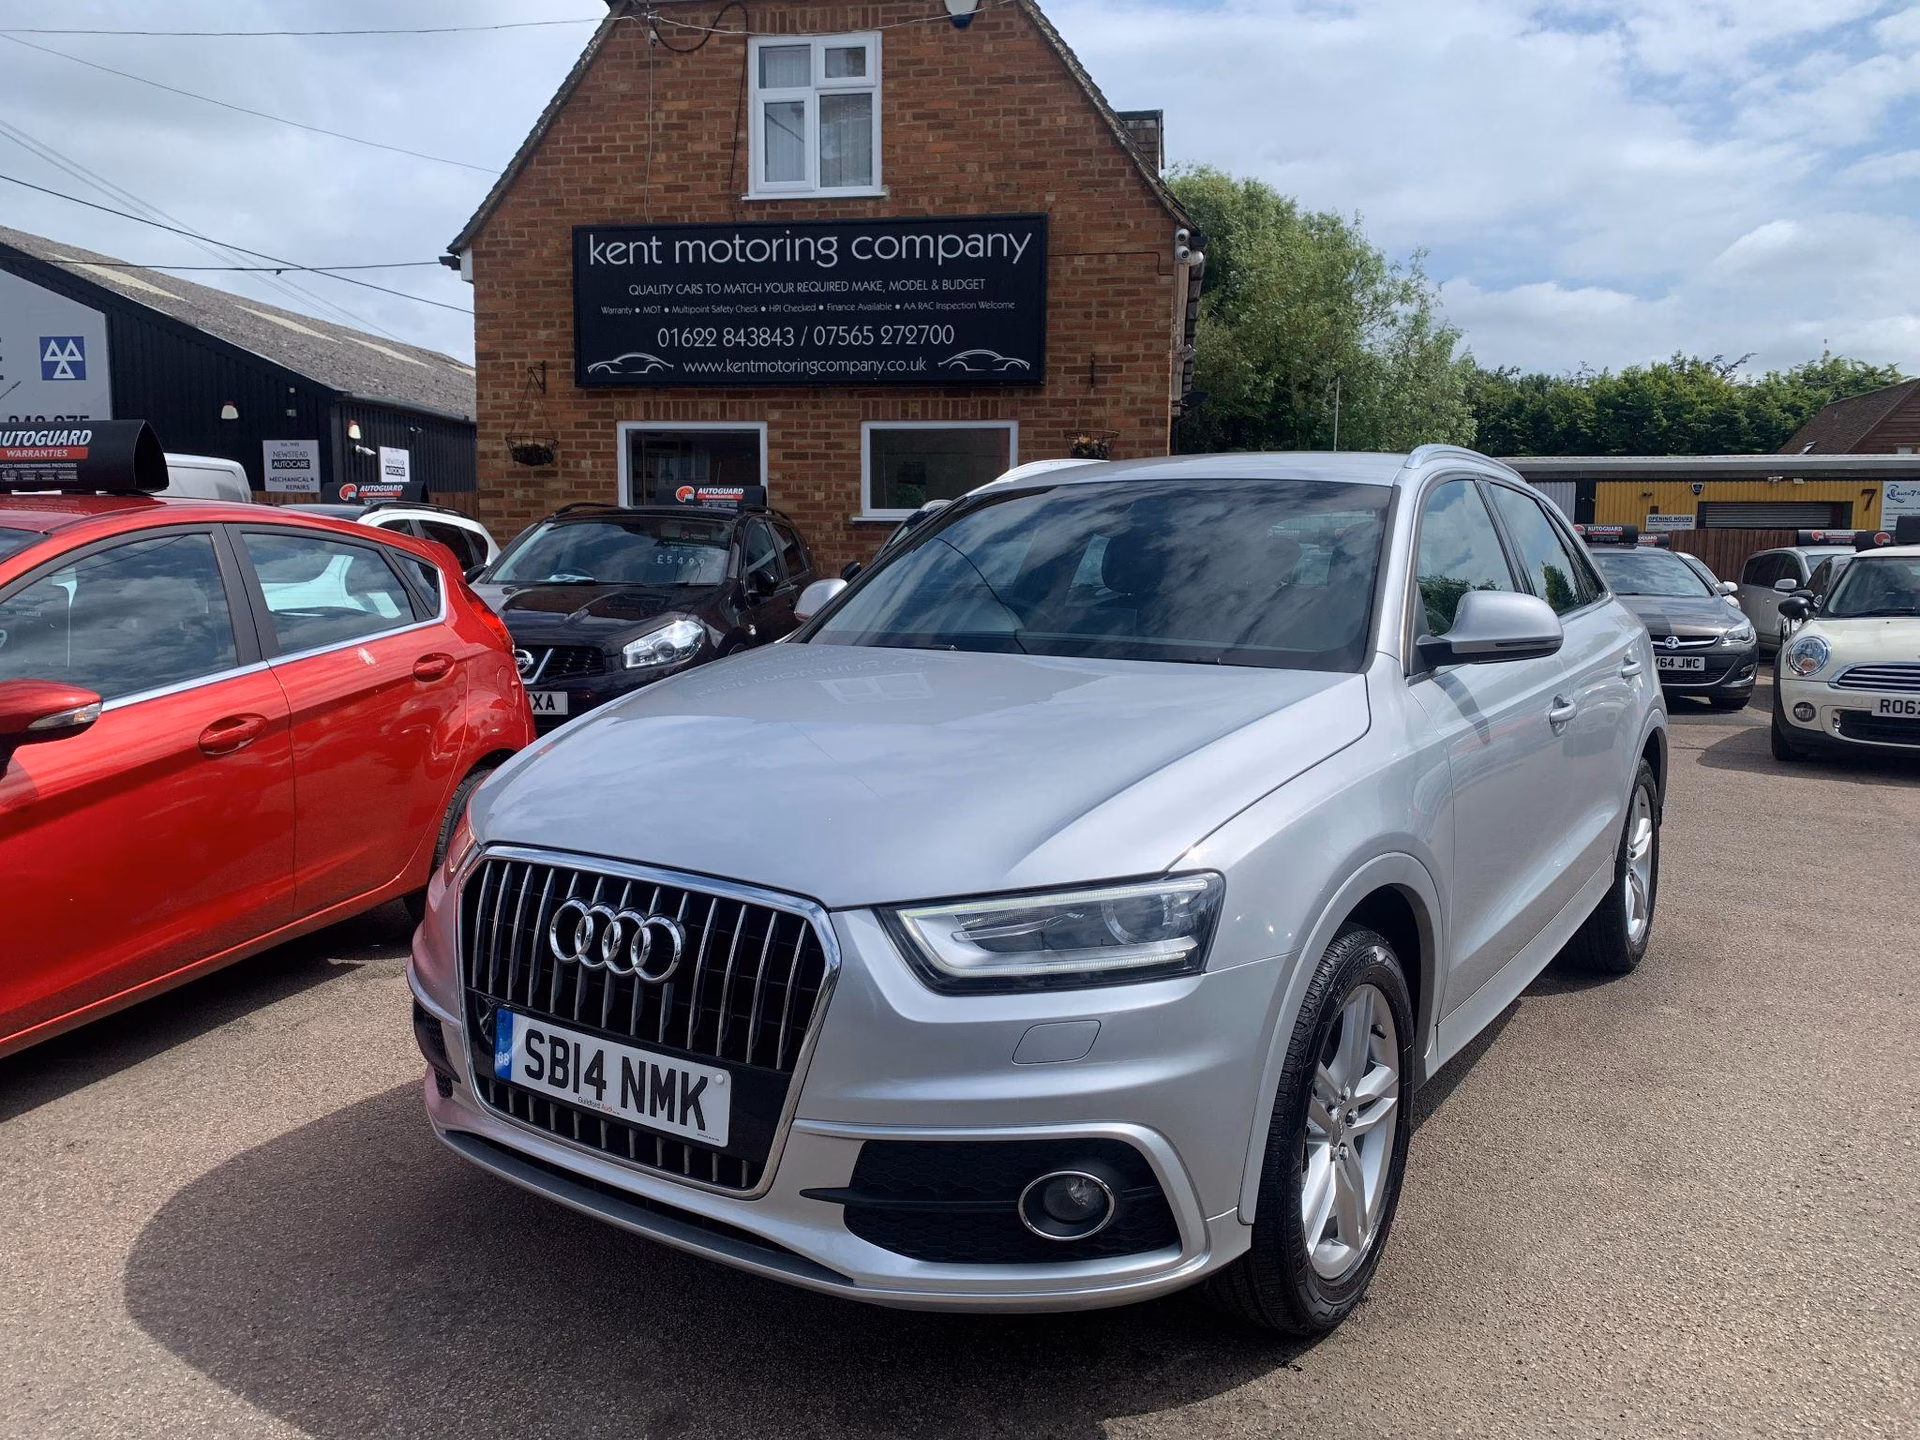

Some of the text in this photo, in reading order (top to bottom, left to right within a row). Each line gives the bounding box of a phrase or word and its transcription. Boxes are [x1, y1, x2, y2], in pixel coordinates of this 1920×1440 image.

[589, 229, 1032, 267] kent motoring company
[629, 279, 986, 296] QUALITY CARS TO MATCH YOUR REQUIRED MAKE, MODEL & BUDGET
[601, 300, 1015, 316] Warranty MOT Multipoint Safety Check HPI Checked Finance Available AA RAC Inspection Welcome
[657, 328, 717, 347] 01622
[723, 327, 795, 347] 843843
[813, 325, 874, 346] 07565
[880, 324, 955, 346] 272700
[683, 356, 927, 375] www.kentmotoringcompany.co.uk
[0, 430, 92, 446] UTOGUARD
[6, 449, 68, 458] WARRANTIES
[273, 450, 308, 458] NEWSTEAD
[273, 459, 309, 469] AUTOCARE
[1860, 489, 1877, 511] 7
[1679, 658, 1700, 669] JWC
[524, 1028, 708, 1131] SB14 NMK
